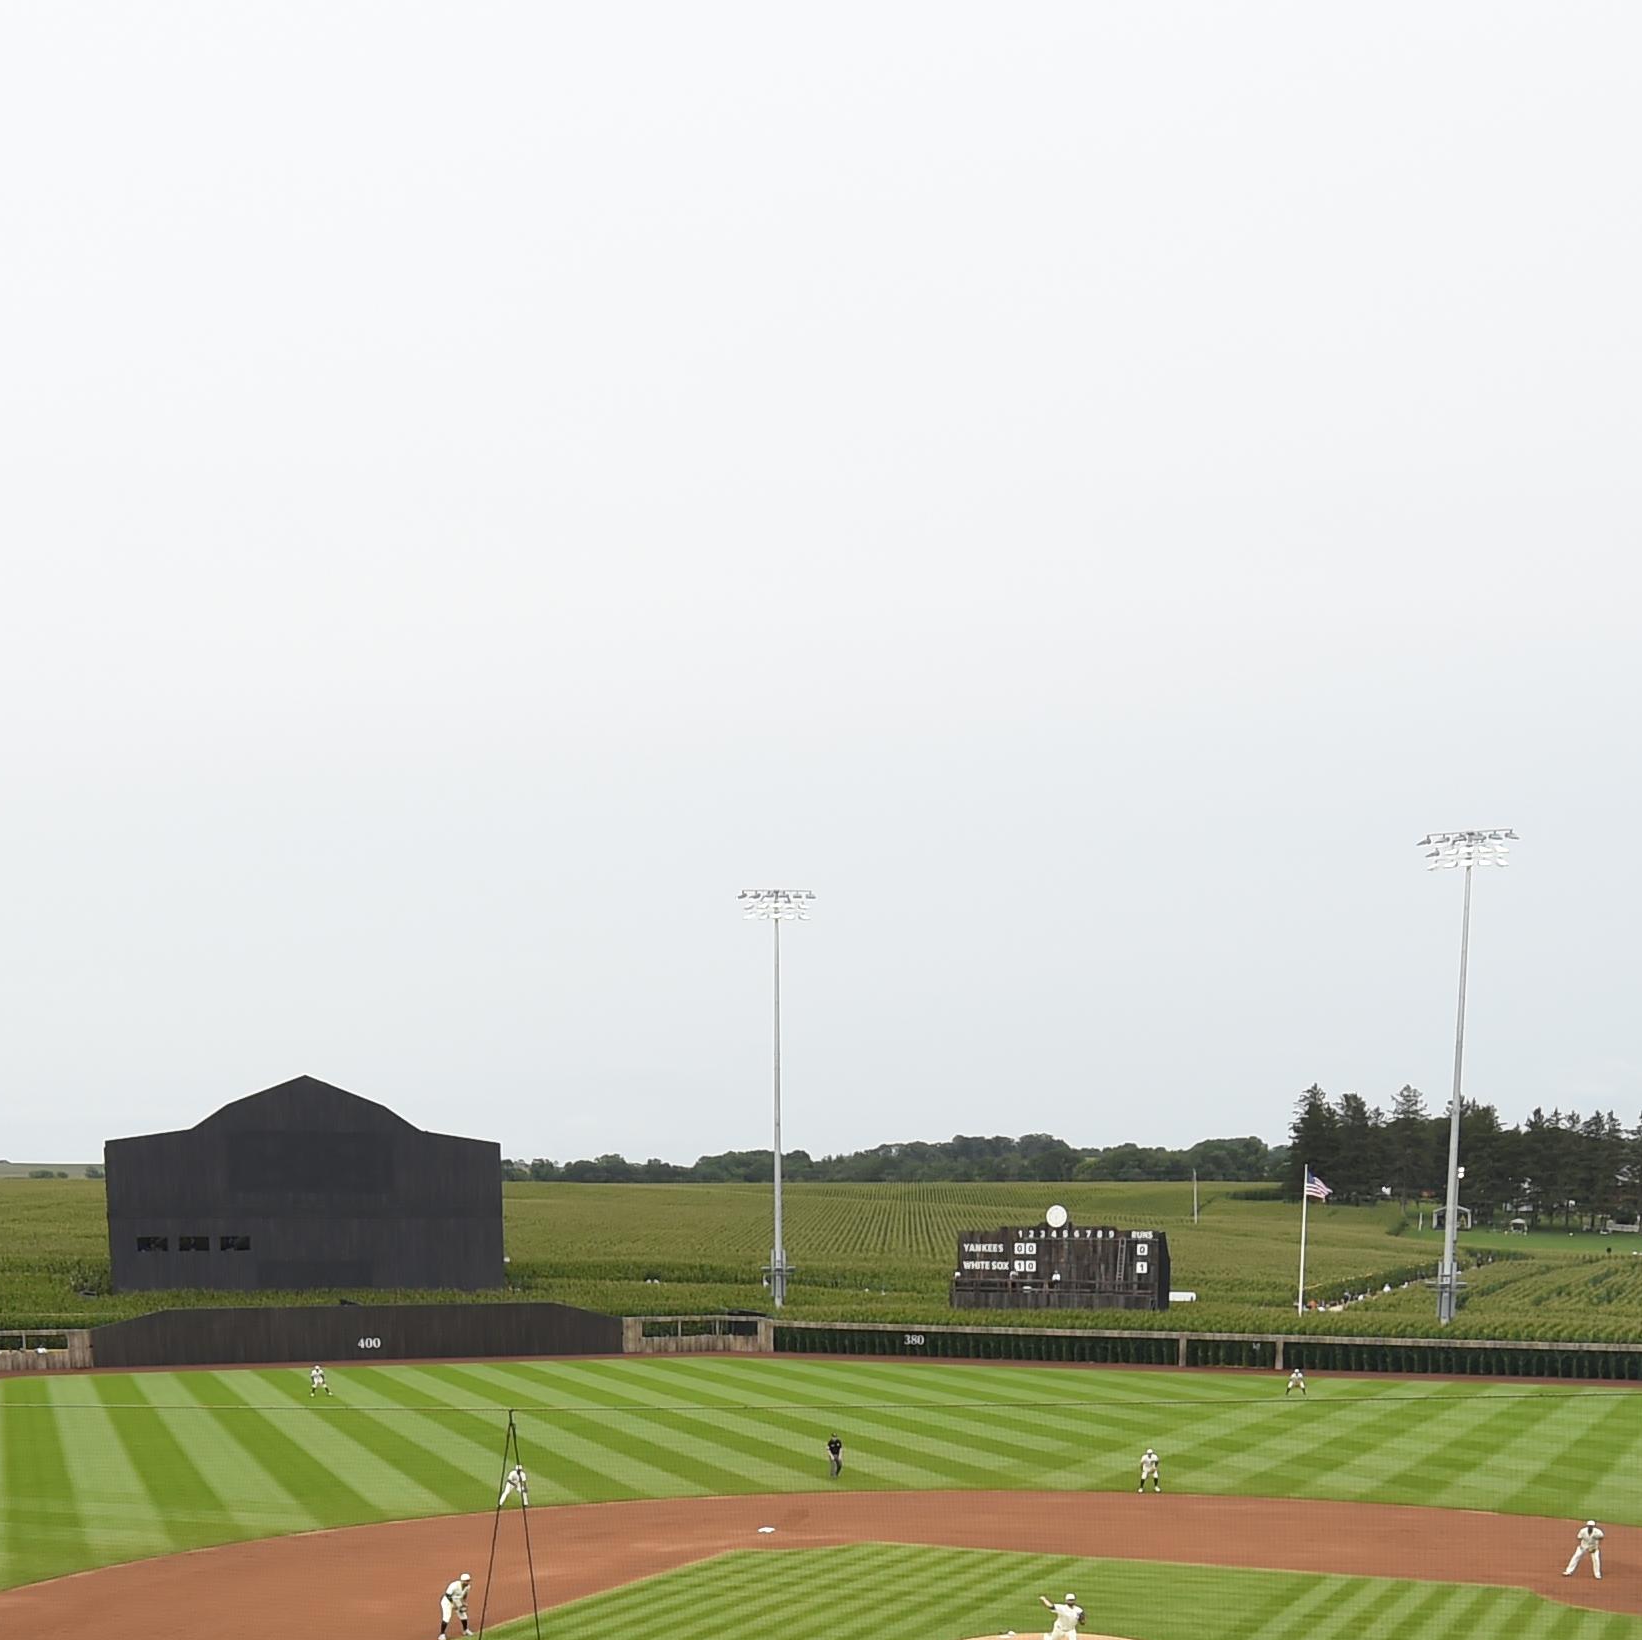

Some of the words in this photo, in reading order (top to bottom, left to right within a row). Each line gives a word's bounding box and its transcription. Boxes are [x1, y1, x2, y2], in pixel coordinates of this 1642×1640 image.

[1131, 1230, 1153, 1239] RUNS
[963, 1243, 1004, 1253] YANKEES
[963, 1260, 990, 1271] WHITE
[991, 1260, 1009, 1271] SOX
[357, 1337, 381, 1349] 400
[903, 1334, 925, 1346] 380
